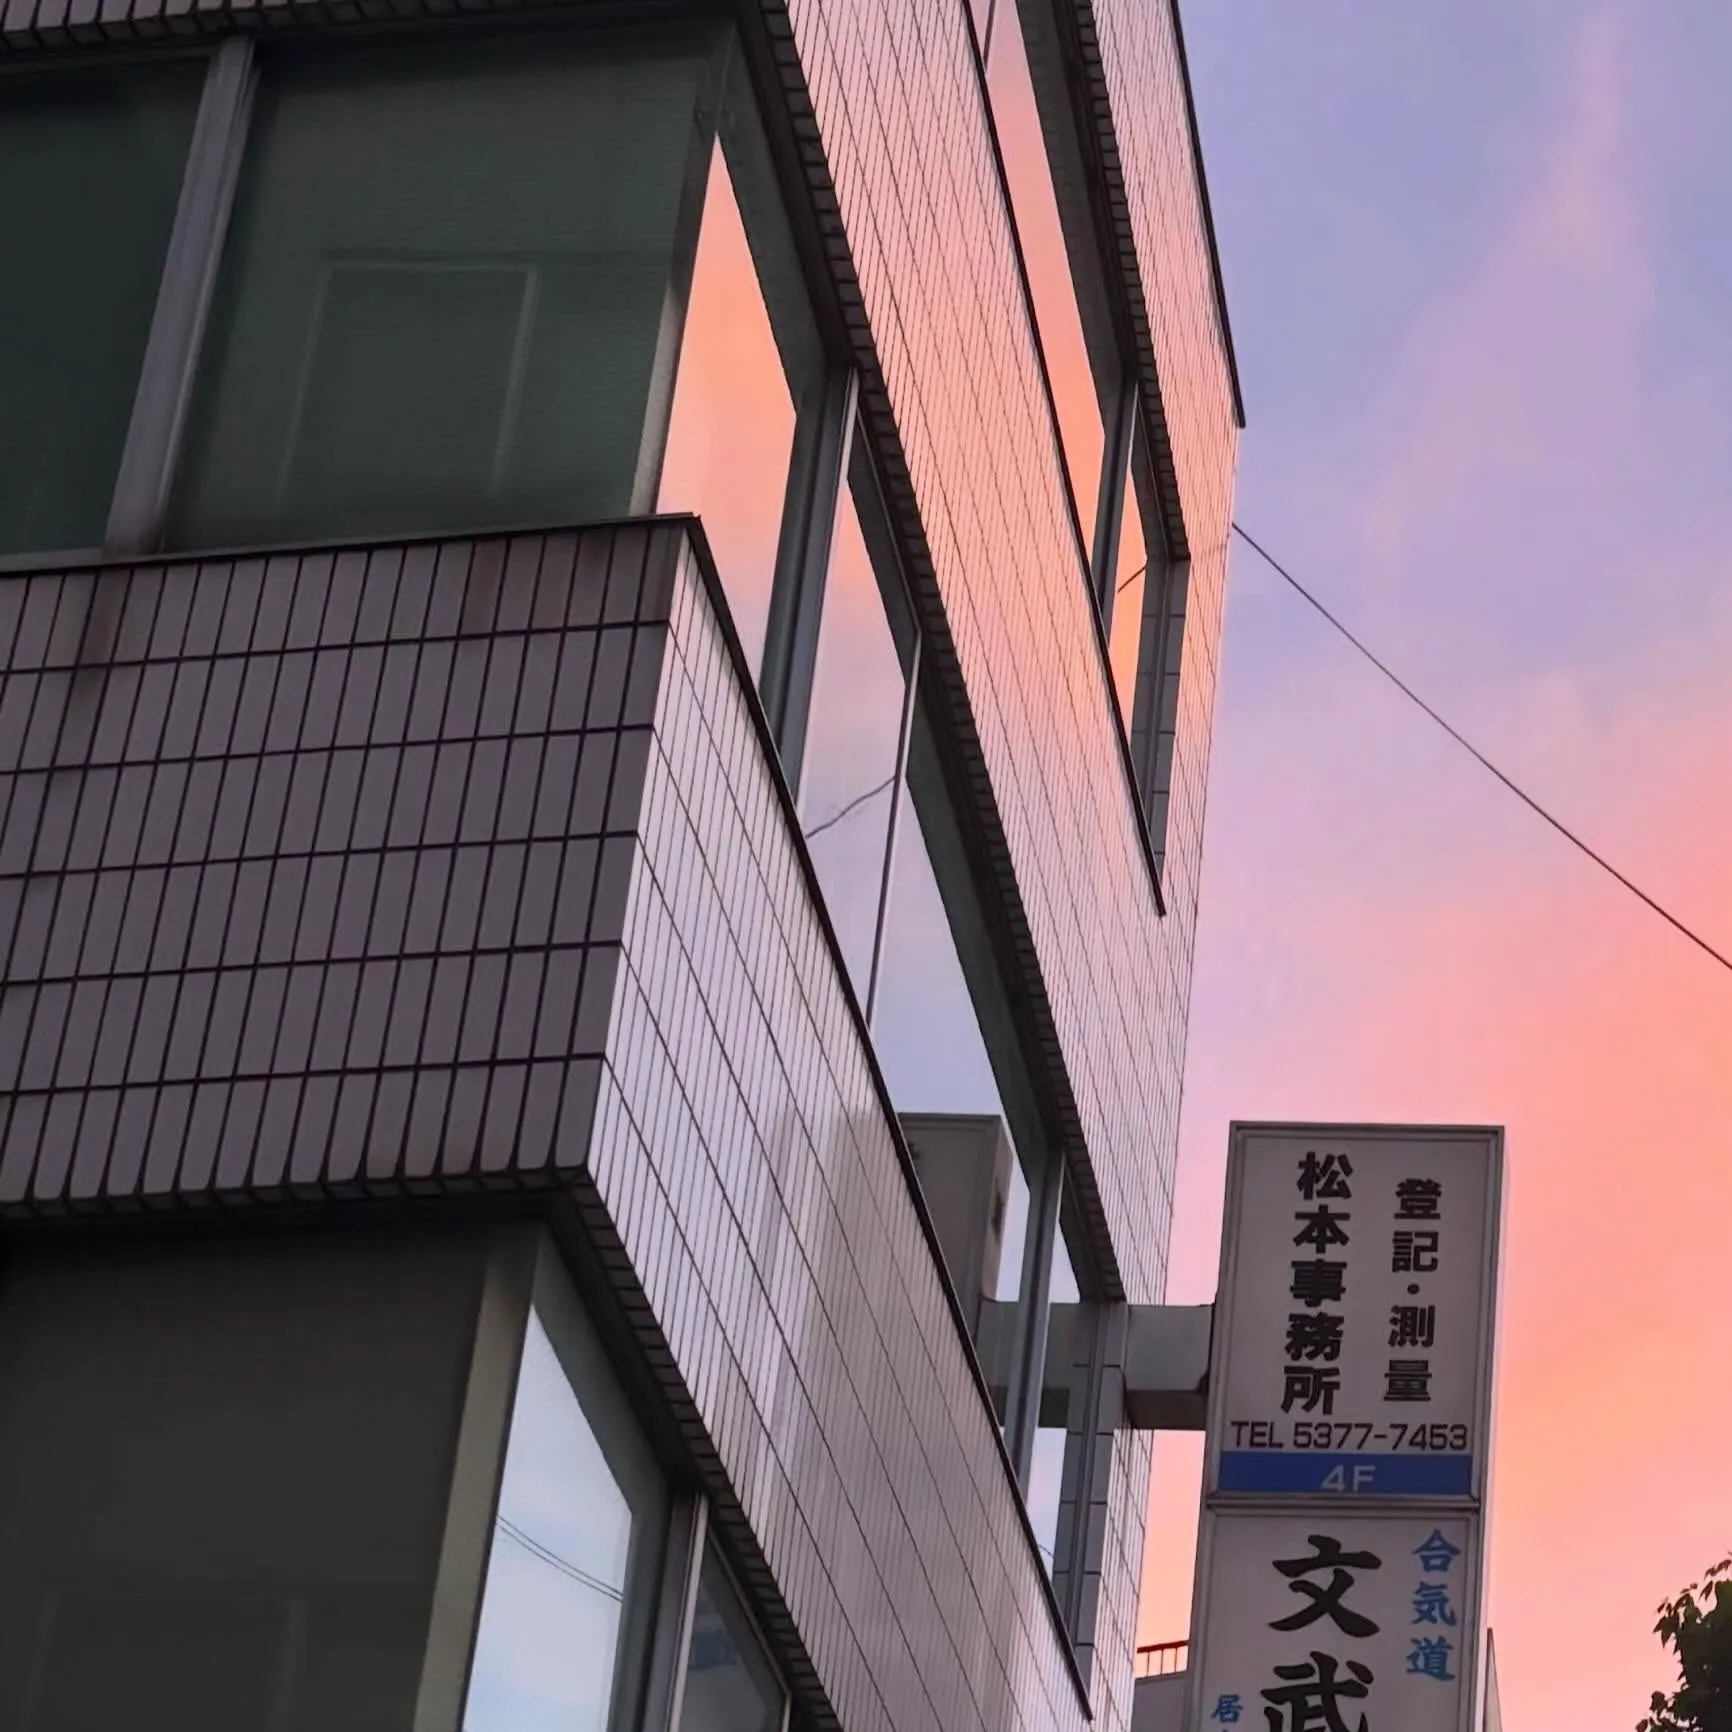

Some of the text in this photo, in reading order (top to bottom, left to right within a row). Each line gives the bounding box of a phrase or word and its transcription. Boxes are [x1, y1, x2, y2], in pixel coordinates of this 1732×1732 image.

[1281, 1151, 1353, 1415] 松本事務所
[1383, 1178, 1442, 1401] 登記・測量
[1231, 1421, 1468, 1450] TEL 5377-7453
[1320, 1465, 1376, 1492] 4F
[1406, 1529, 1461, 1680] 合気道
